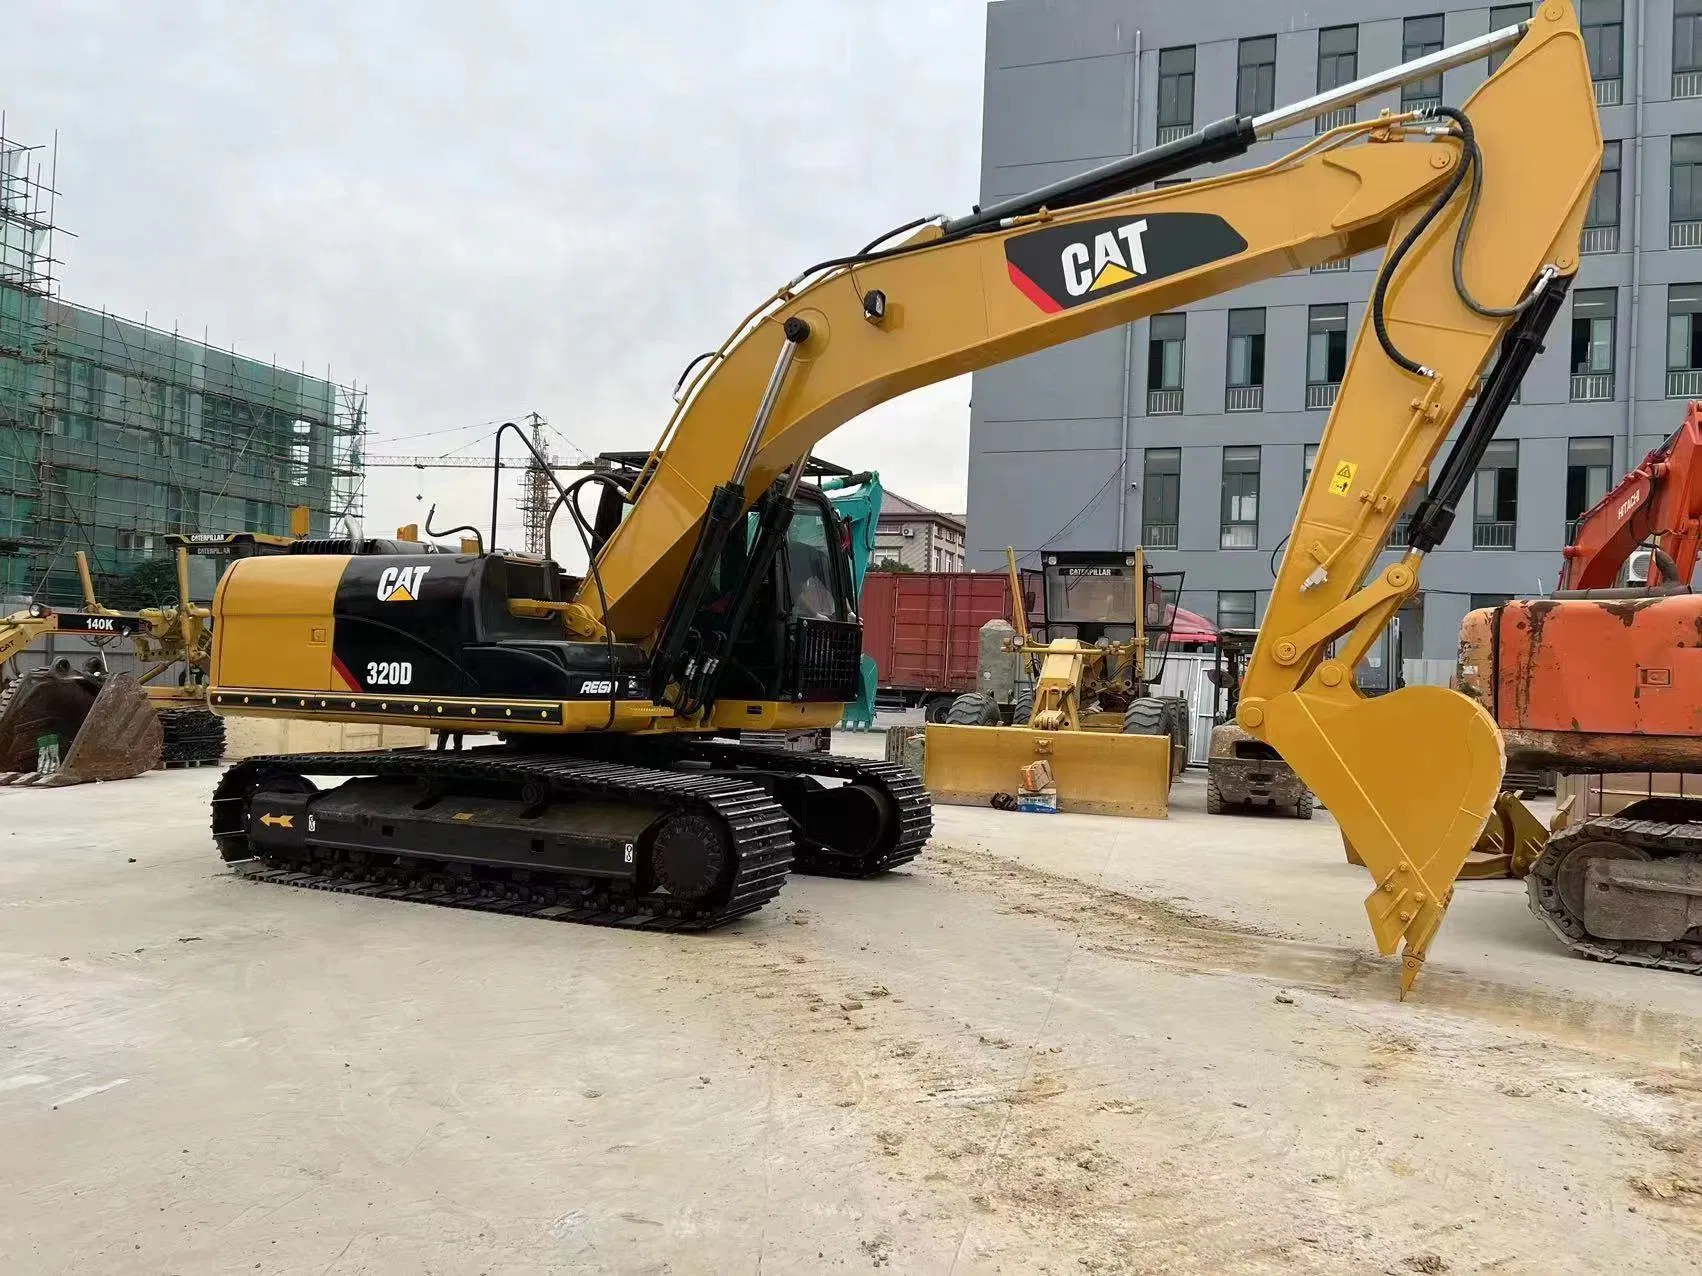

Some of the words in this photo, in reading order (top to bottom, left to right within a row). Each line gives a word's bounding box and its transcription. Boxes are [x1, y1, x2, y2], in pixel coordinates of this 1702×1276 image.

[1061, 218, 1148, 297] CAT
[1617, 489, 1640, 520] HITACHI
[191, 534, 225, 542] CATERPILLAR
[376, 565, 431, 601] CAT
[86, 618, 114, 630] 140K
[0, 639, 15, 653] CAT
[366, 661, 412, 685] 320D
